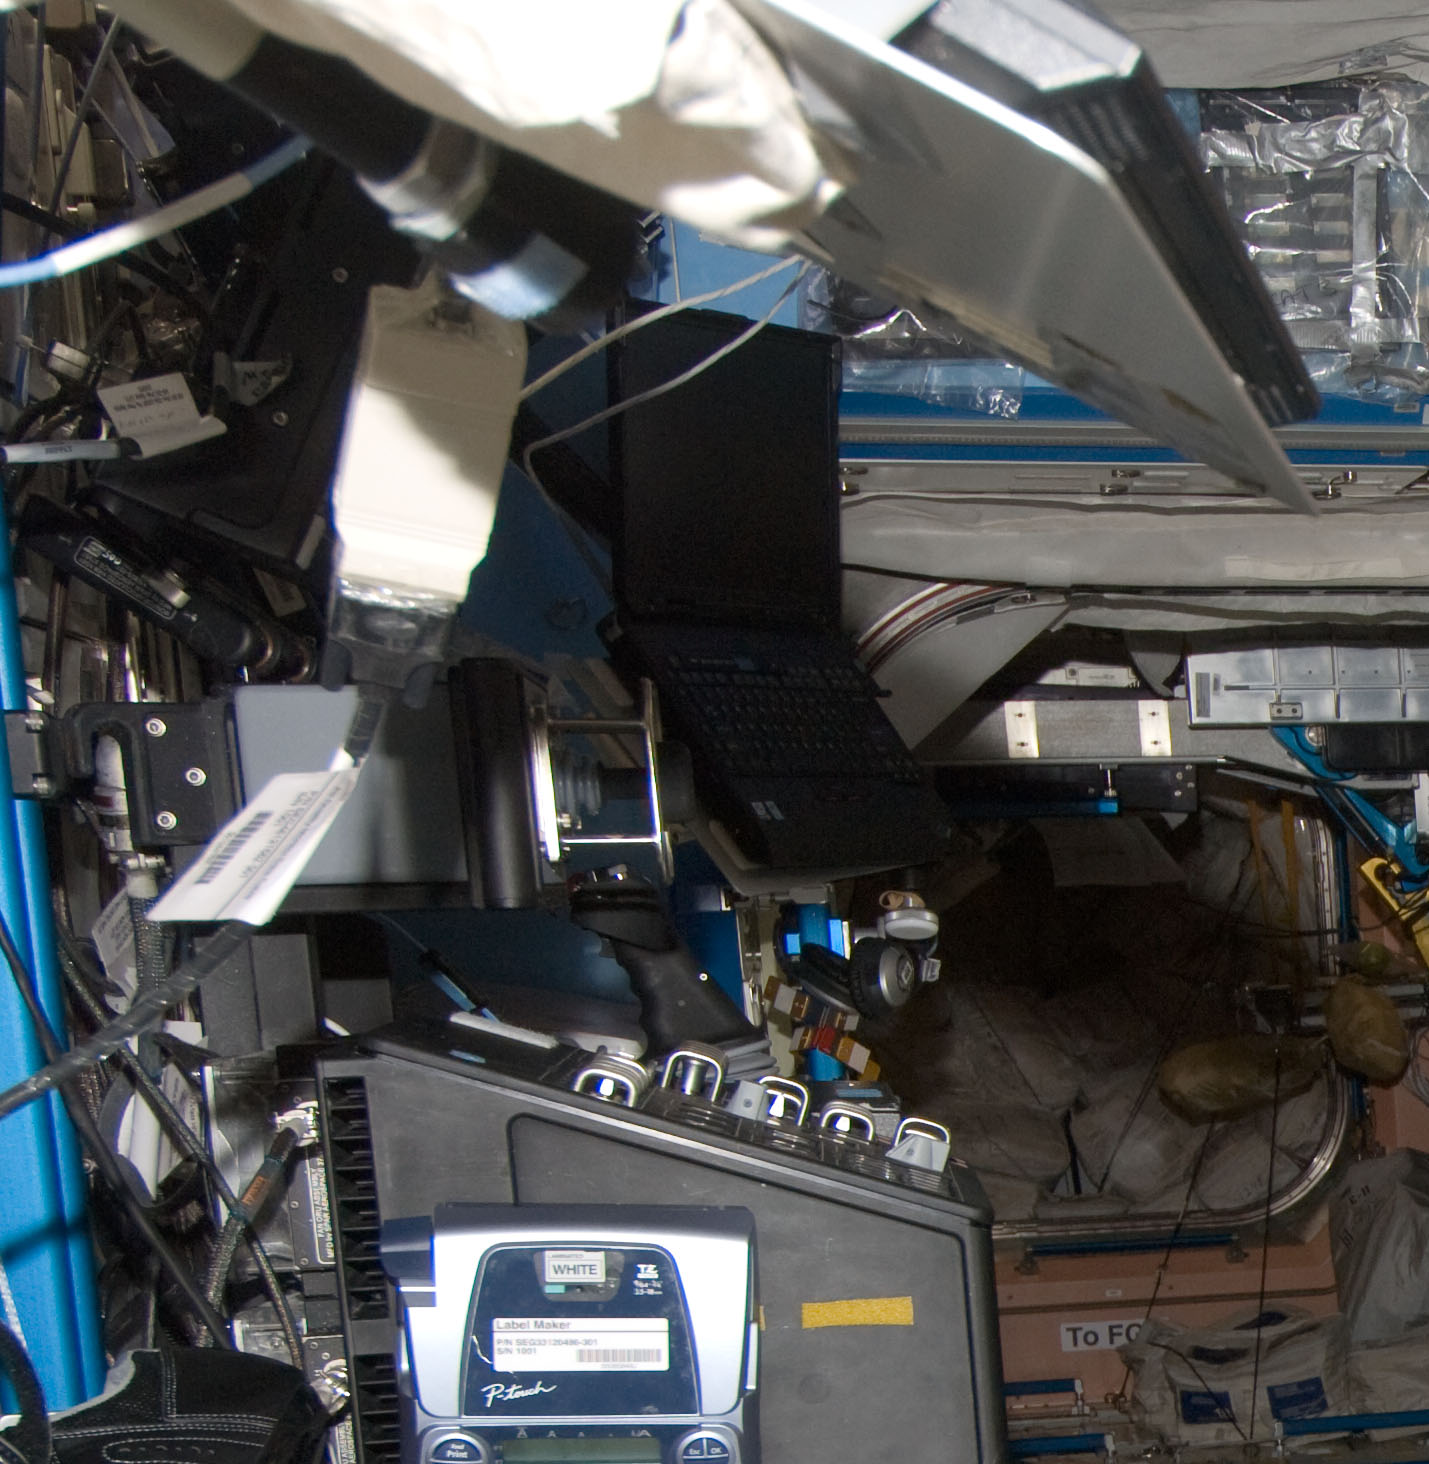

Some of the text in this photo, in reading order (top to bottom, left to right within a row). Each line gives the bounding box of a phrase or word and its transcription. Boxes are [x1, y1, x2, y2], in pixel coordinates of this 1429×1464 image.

[318, 1166, 329, 1211] AEROSPACE
[310, 1166, 324, 1236] FAN ORU ASSEMBLY
[323, 1212, 332, 1230] SPAR
[326, 1241, 334, 1256] MFD
[552, 1264, 598, 1275] WHITE
[496, 1320, 570, 1329] Label Maker
[497, 1338, 512, 1346] P/N
[1066, 1327, 1099, 1348] To
[497, 1347, 512, 1355] S/N
[480, 1381, 558, 1407] P-touch
[446, 1449, 468, 1459] Print
